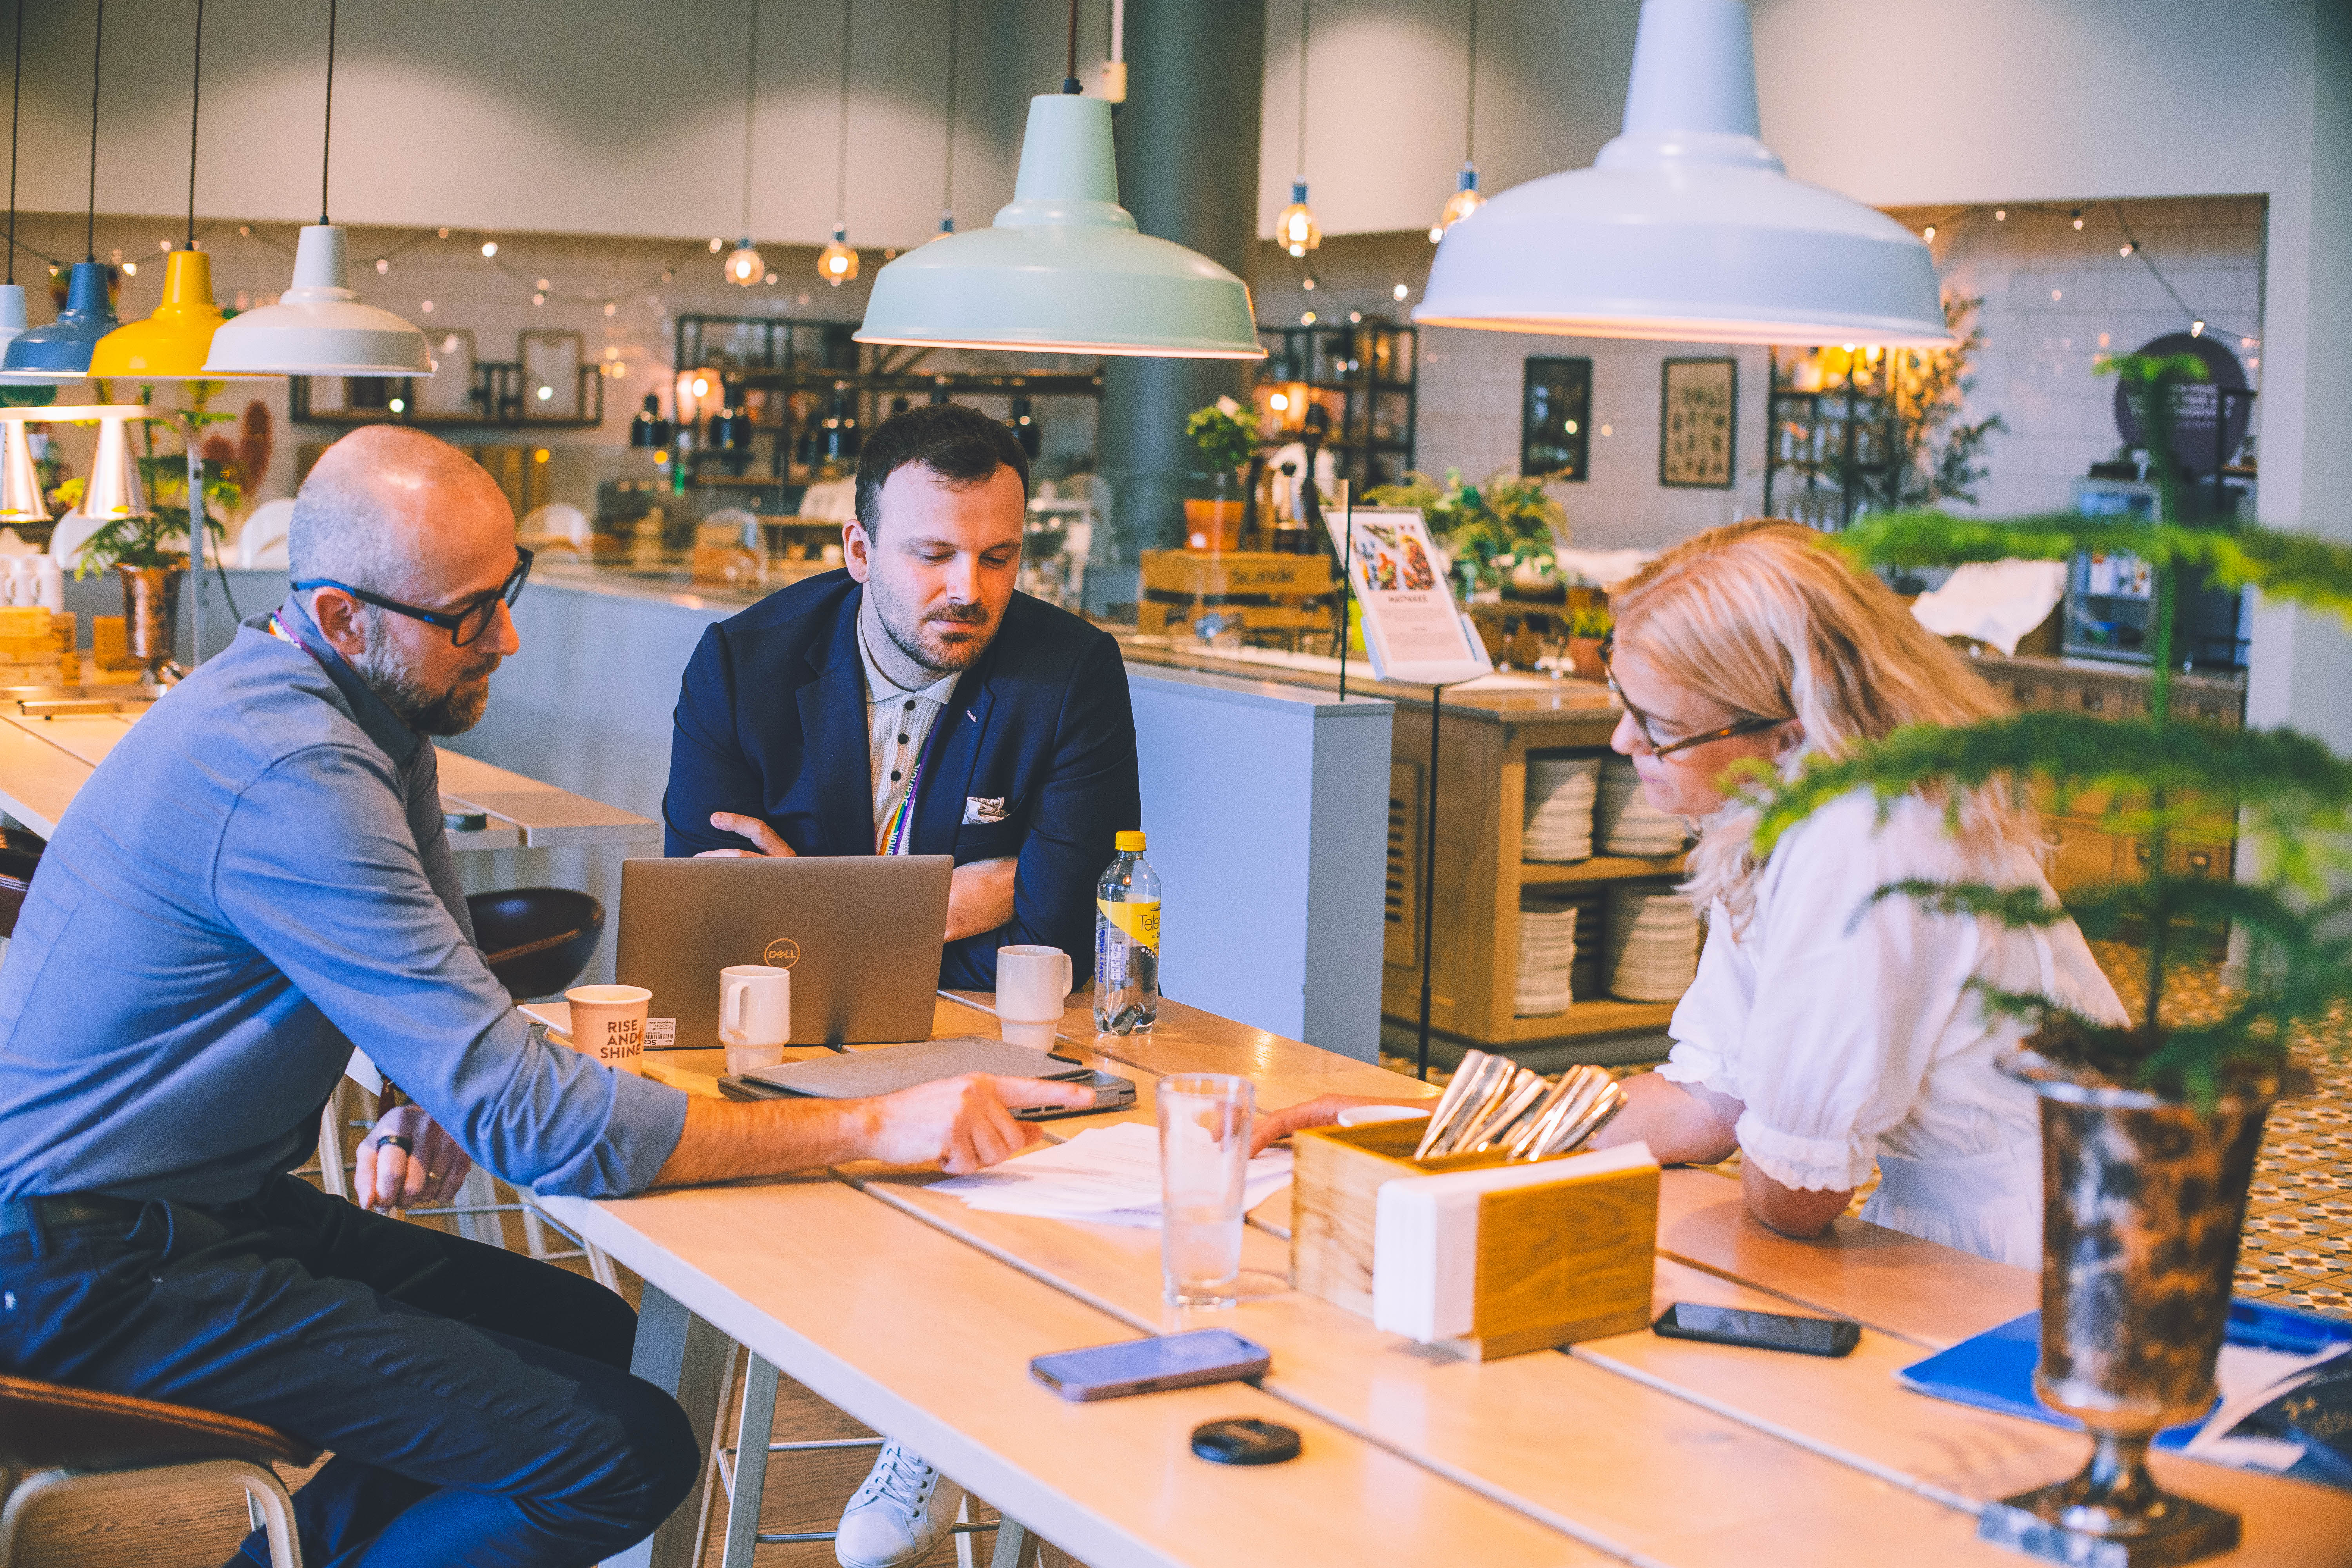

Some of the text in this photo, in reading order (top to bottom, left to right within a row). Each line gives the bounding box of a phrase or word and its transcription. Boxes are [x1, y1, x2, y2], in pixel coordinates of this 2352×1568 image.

[884, 830, 899, 856] andic
[1137, 914, 1160, 931] Tele
[769, 950, 796, 958] DELL
[608, 1019, 637, 1033] RISE
[607, 1032, 637, 1045] AND
[601, 1044, 641, 1058] SHINE
